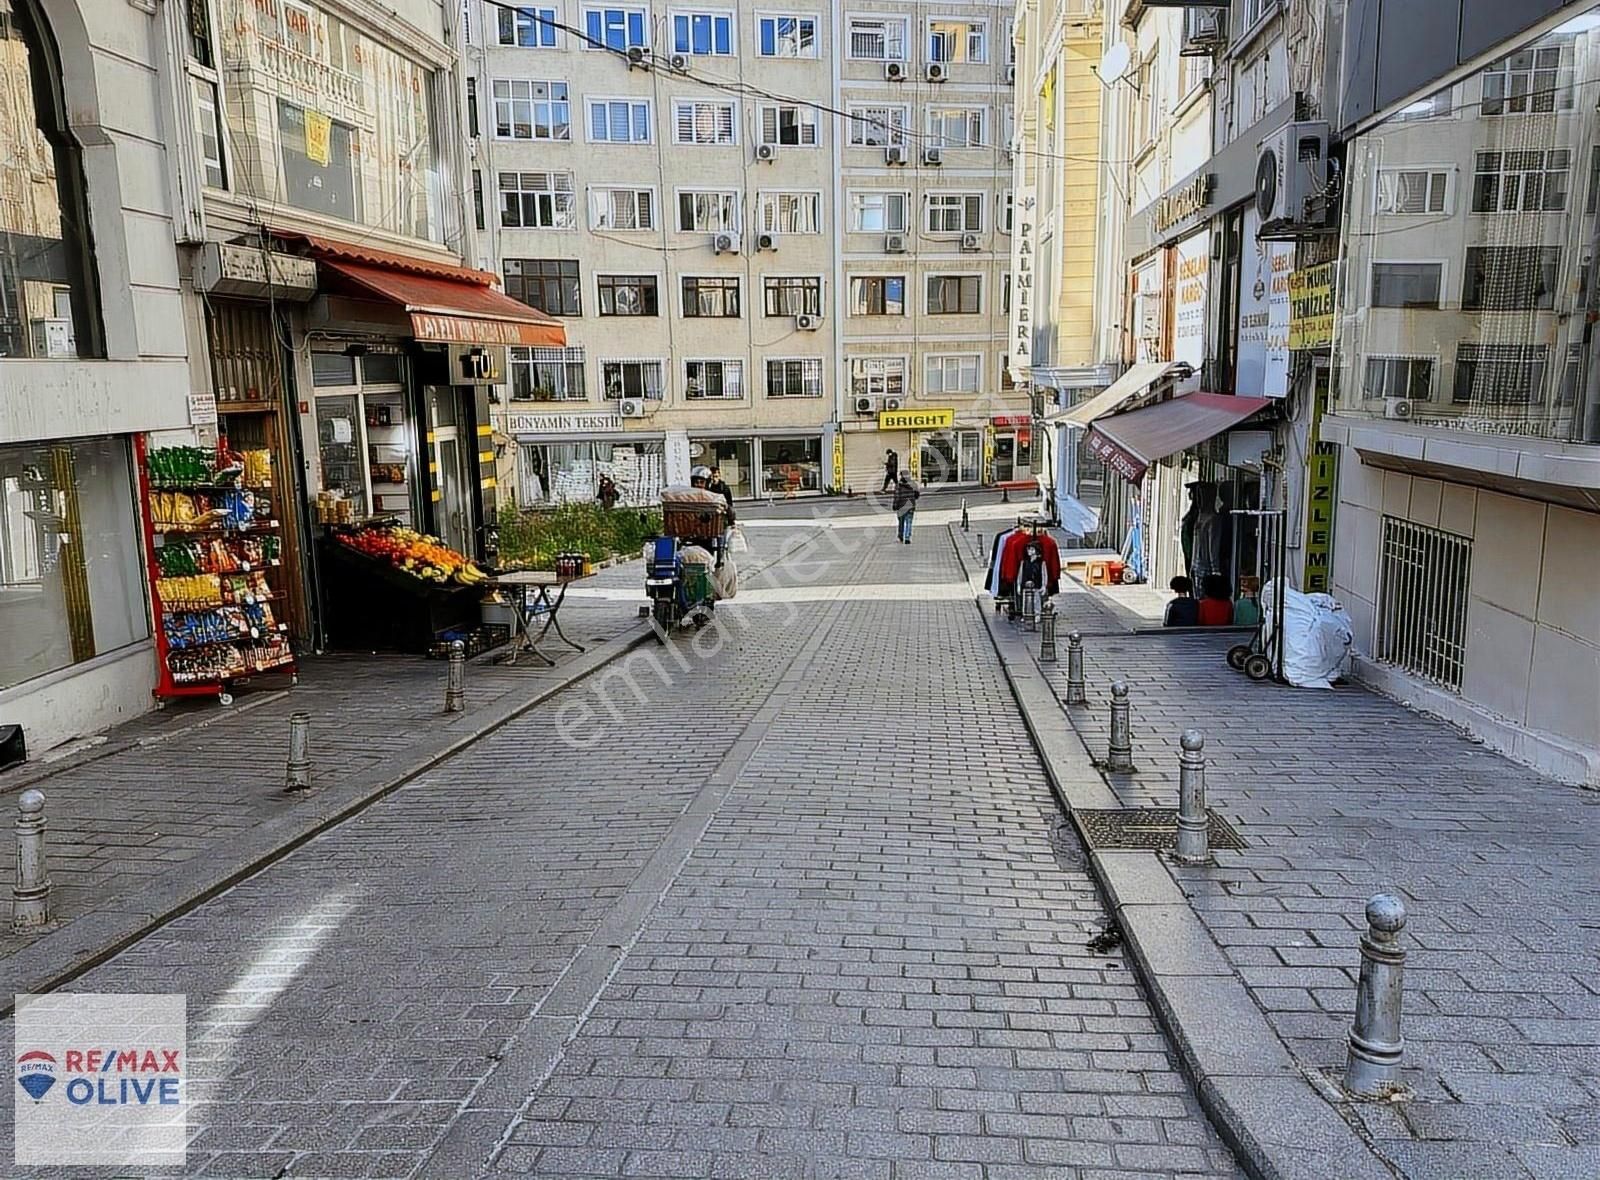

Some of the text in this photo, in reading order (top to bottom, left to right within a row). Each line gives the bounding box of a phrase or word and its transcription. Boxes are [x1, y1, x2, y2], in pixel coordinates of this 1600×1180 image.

[1306, 264, 1331, 289] KURU
[509, 413, 622, 429] BÜNYAMİN TEKSTİL
[885, 414, 947, 427] BRIGHT
[1308, 396, 1333, 588] TMİZLEME
